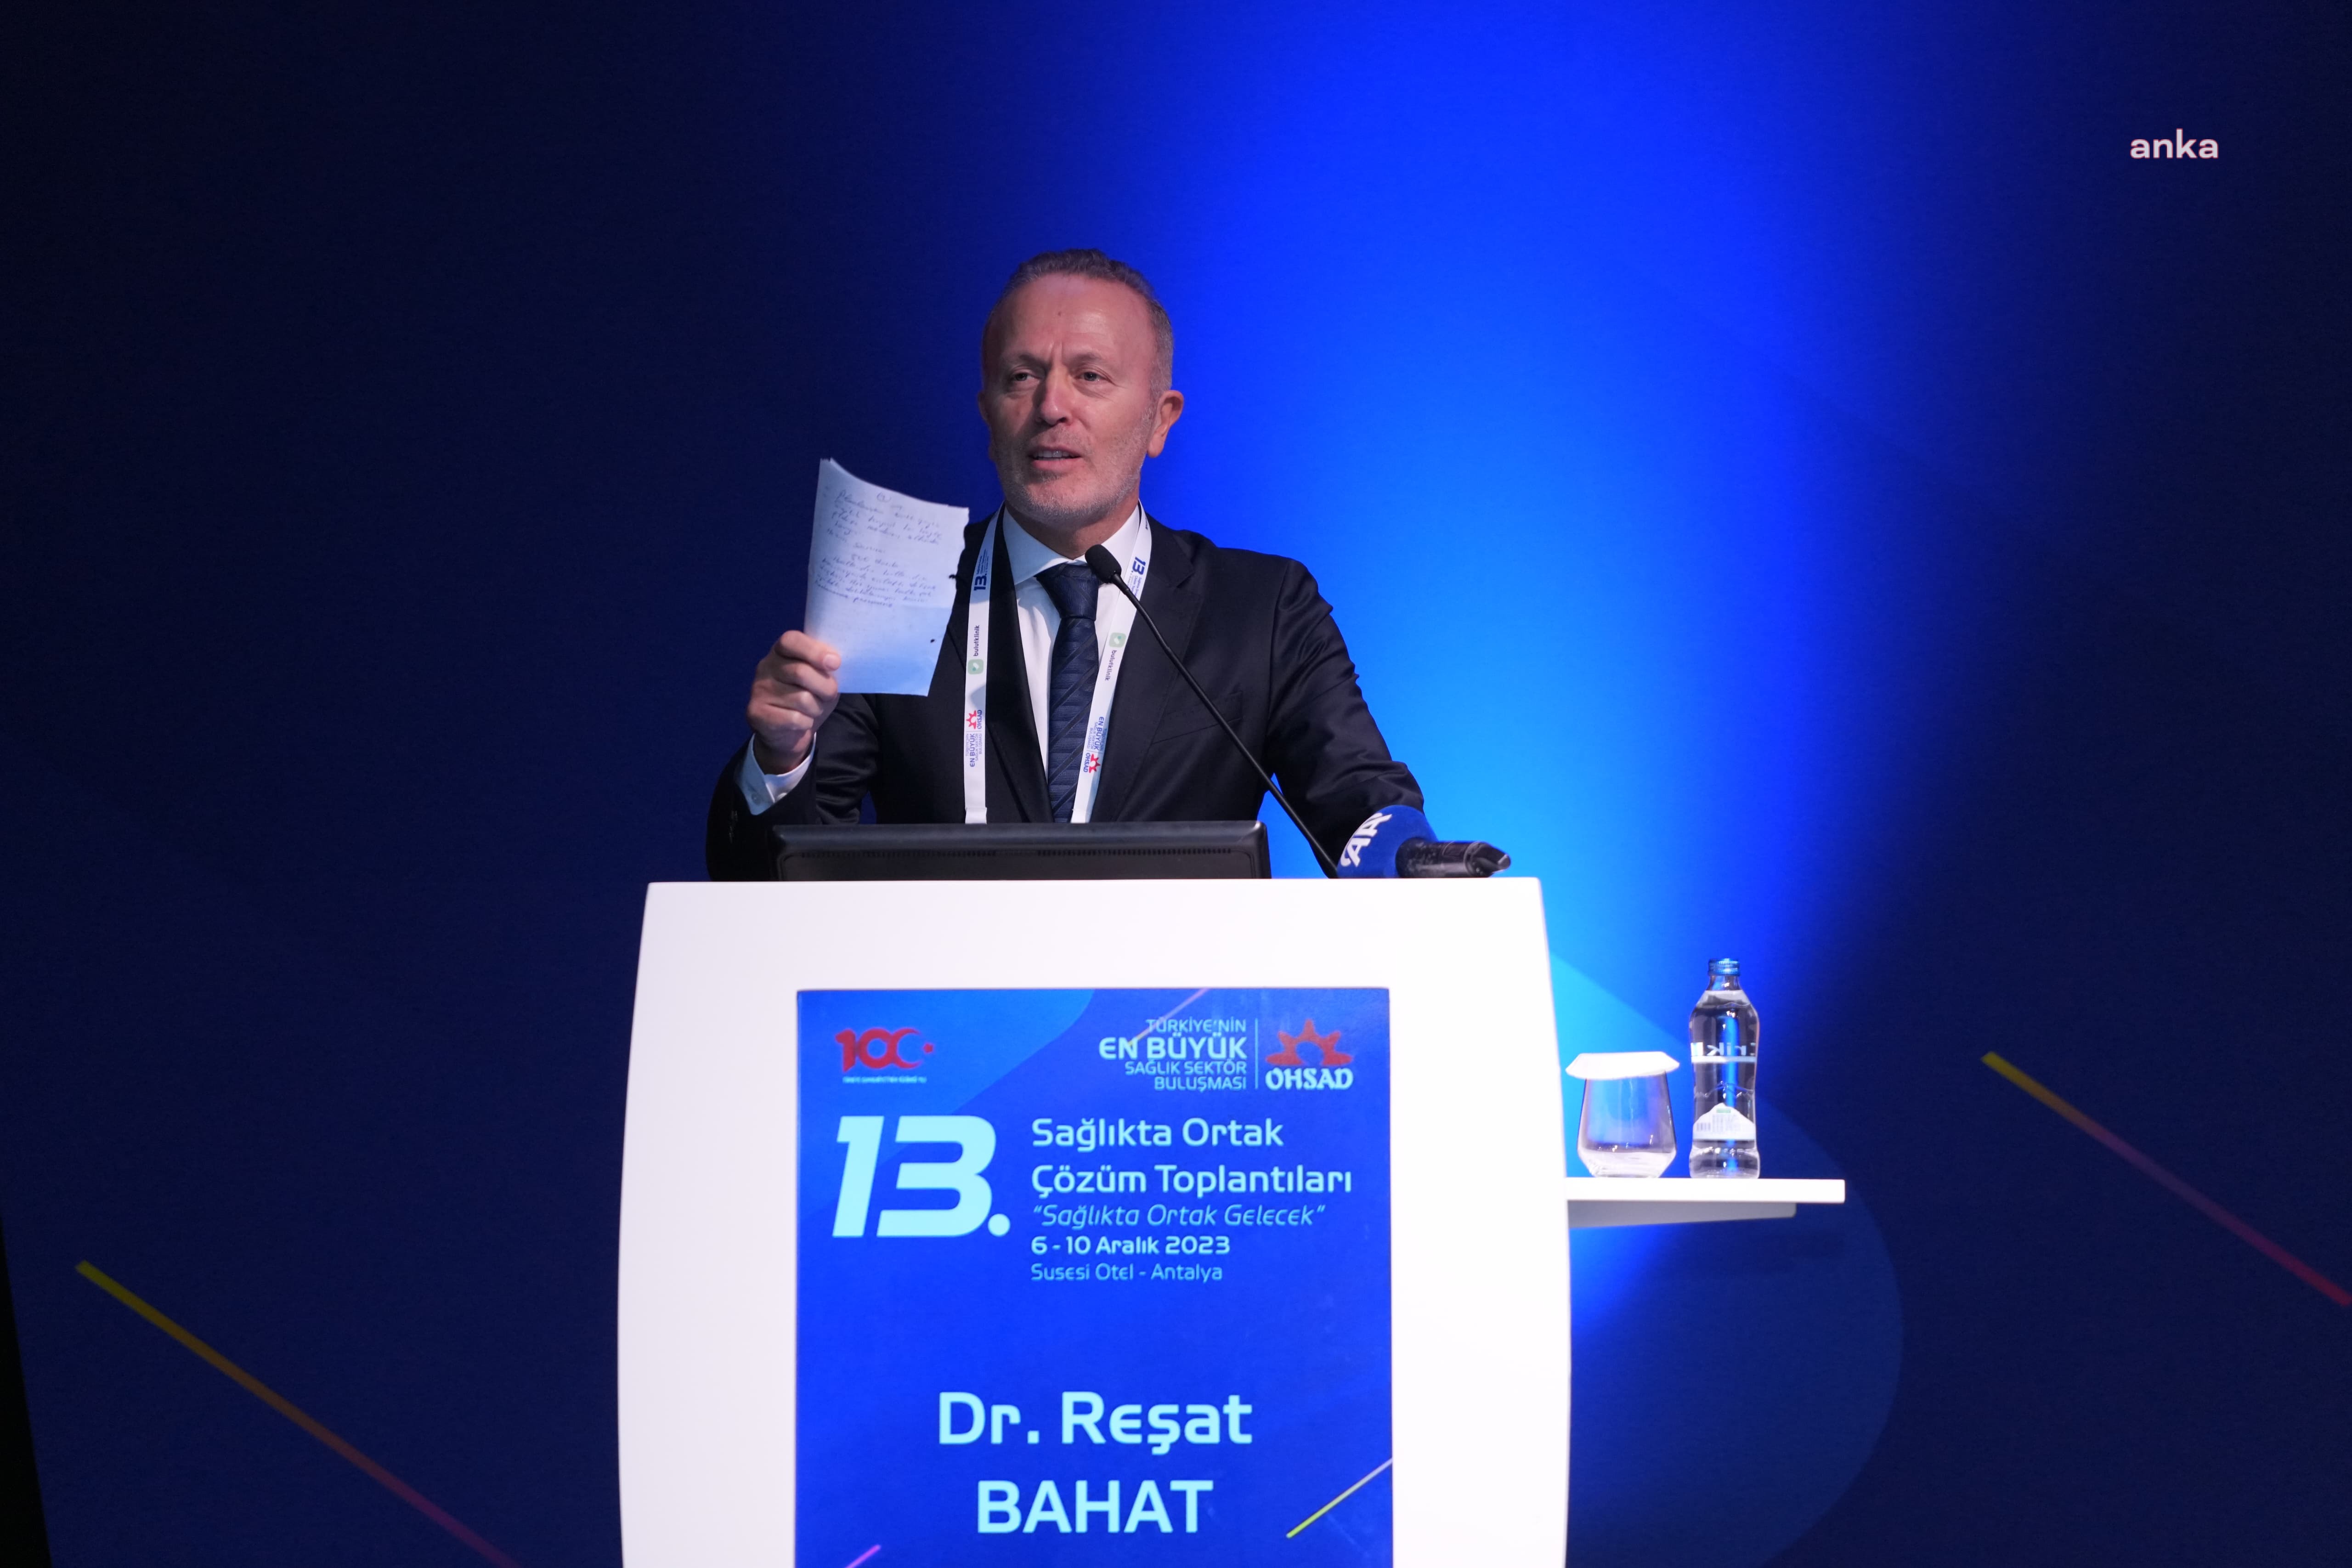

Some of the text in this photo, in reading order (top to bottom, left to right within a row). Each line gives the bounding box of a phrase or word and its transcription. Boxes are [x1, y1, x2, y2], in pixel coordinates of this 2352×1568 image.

[1131, 557, 1146, 575] 13.
[974, 573, 987, 591] 13.
[1105, 650, 1117, 681] bulutklinik
[1094, 717, 1104, 750] EN BÜYÜK
[970, 758, 975, 767] EN
[1146, 1019, 1246, 1033] TÜRKİYE'NİN
[1099, 1032, 1247, 1060] EN BÜYÜK
[1125, 1059, 1247, 1075] SAĞLIK SEKTÖR
[1154, 1076, 1246, 1092] BULUŞMASI
[1265, 1067, 1354, 1090] OHSAD
[1032, 1118, 1284, 1152] Sağlıkta Ortak
[832, 1115, 1010, 1237] 13.
[1032, 1165, 1352, 1198] Çözüm Toplantıları
[1147, 1204, 1218, 1225] Ortak
[1031, 1236, 1048, 1255] 6
[1066, 1236, 1091, 1254] 10
[1096, 1236, 1159, 1254] Aralık
[1165, 1235, 1231, 1254] 2023
[1031, 1263, 1090, 1280] Susesi
[1095, 1262, 1134, 1280] Otel
[1151, 1262, 1223, 1283] Antalya
[939, 1391, 1253, 1455] Dr. Reşat
[978, 1480, 1214, 1533] BAHAT
